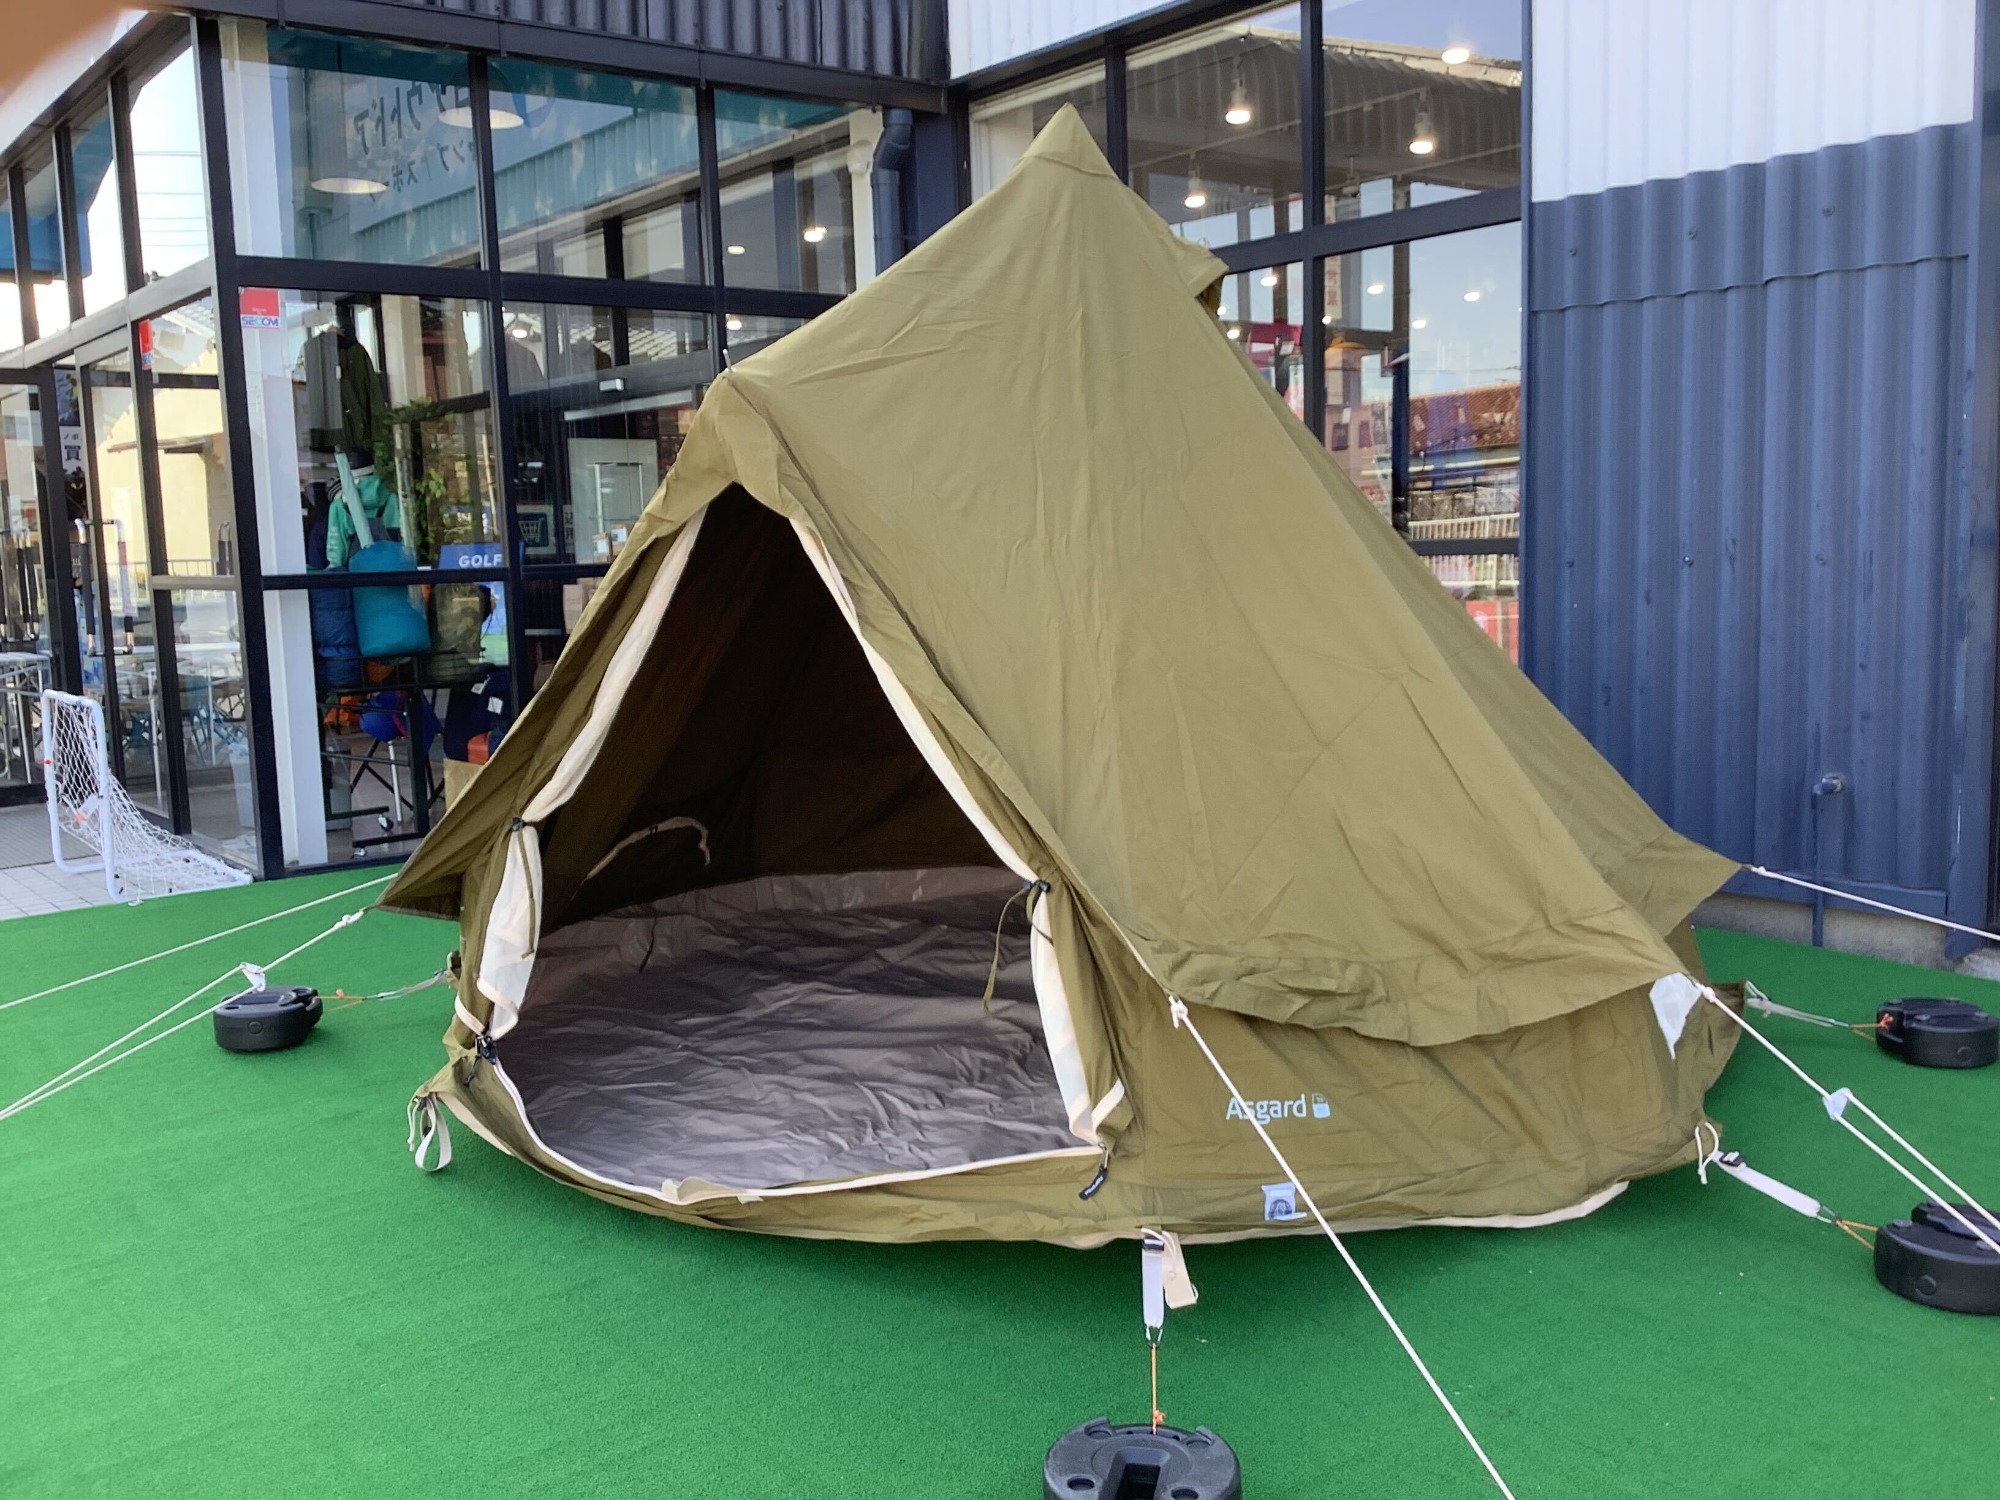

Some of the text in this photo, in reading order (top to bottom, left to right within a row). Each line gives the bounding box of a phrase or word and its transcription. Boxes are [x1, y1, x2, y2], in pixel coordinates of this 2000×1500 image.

[241, 316, 279, 327] SECOM
[458, 553, 503, 569] GOLF
[1225, 1093, 1307, 1125] Asgard
